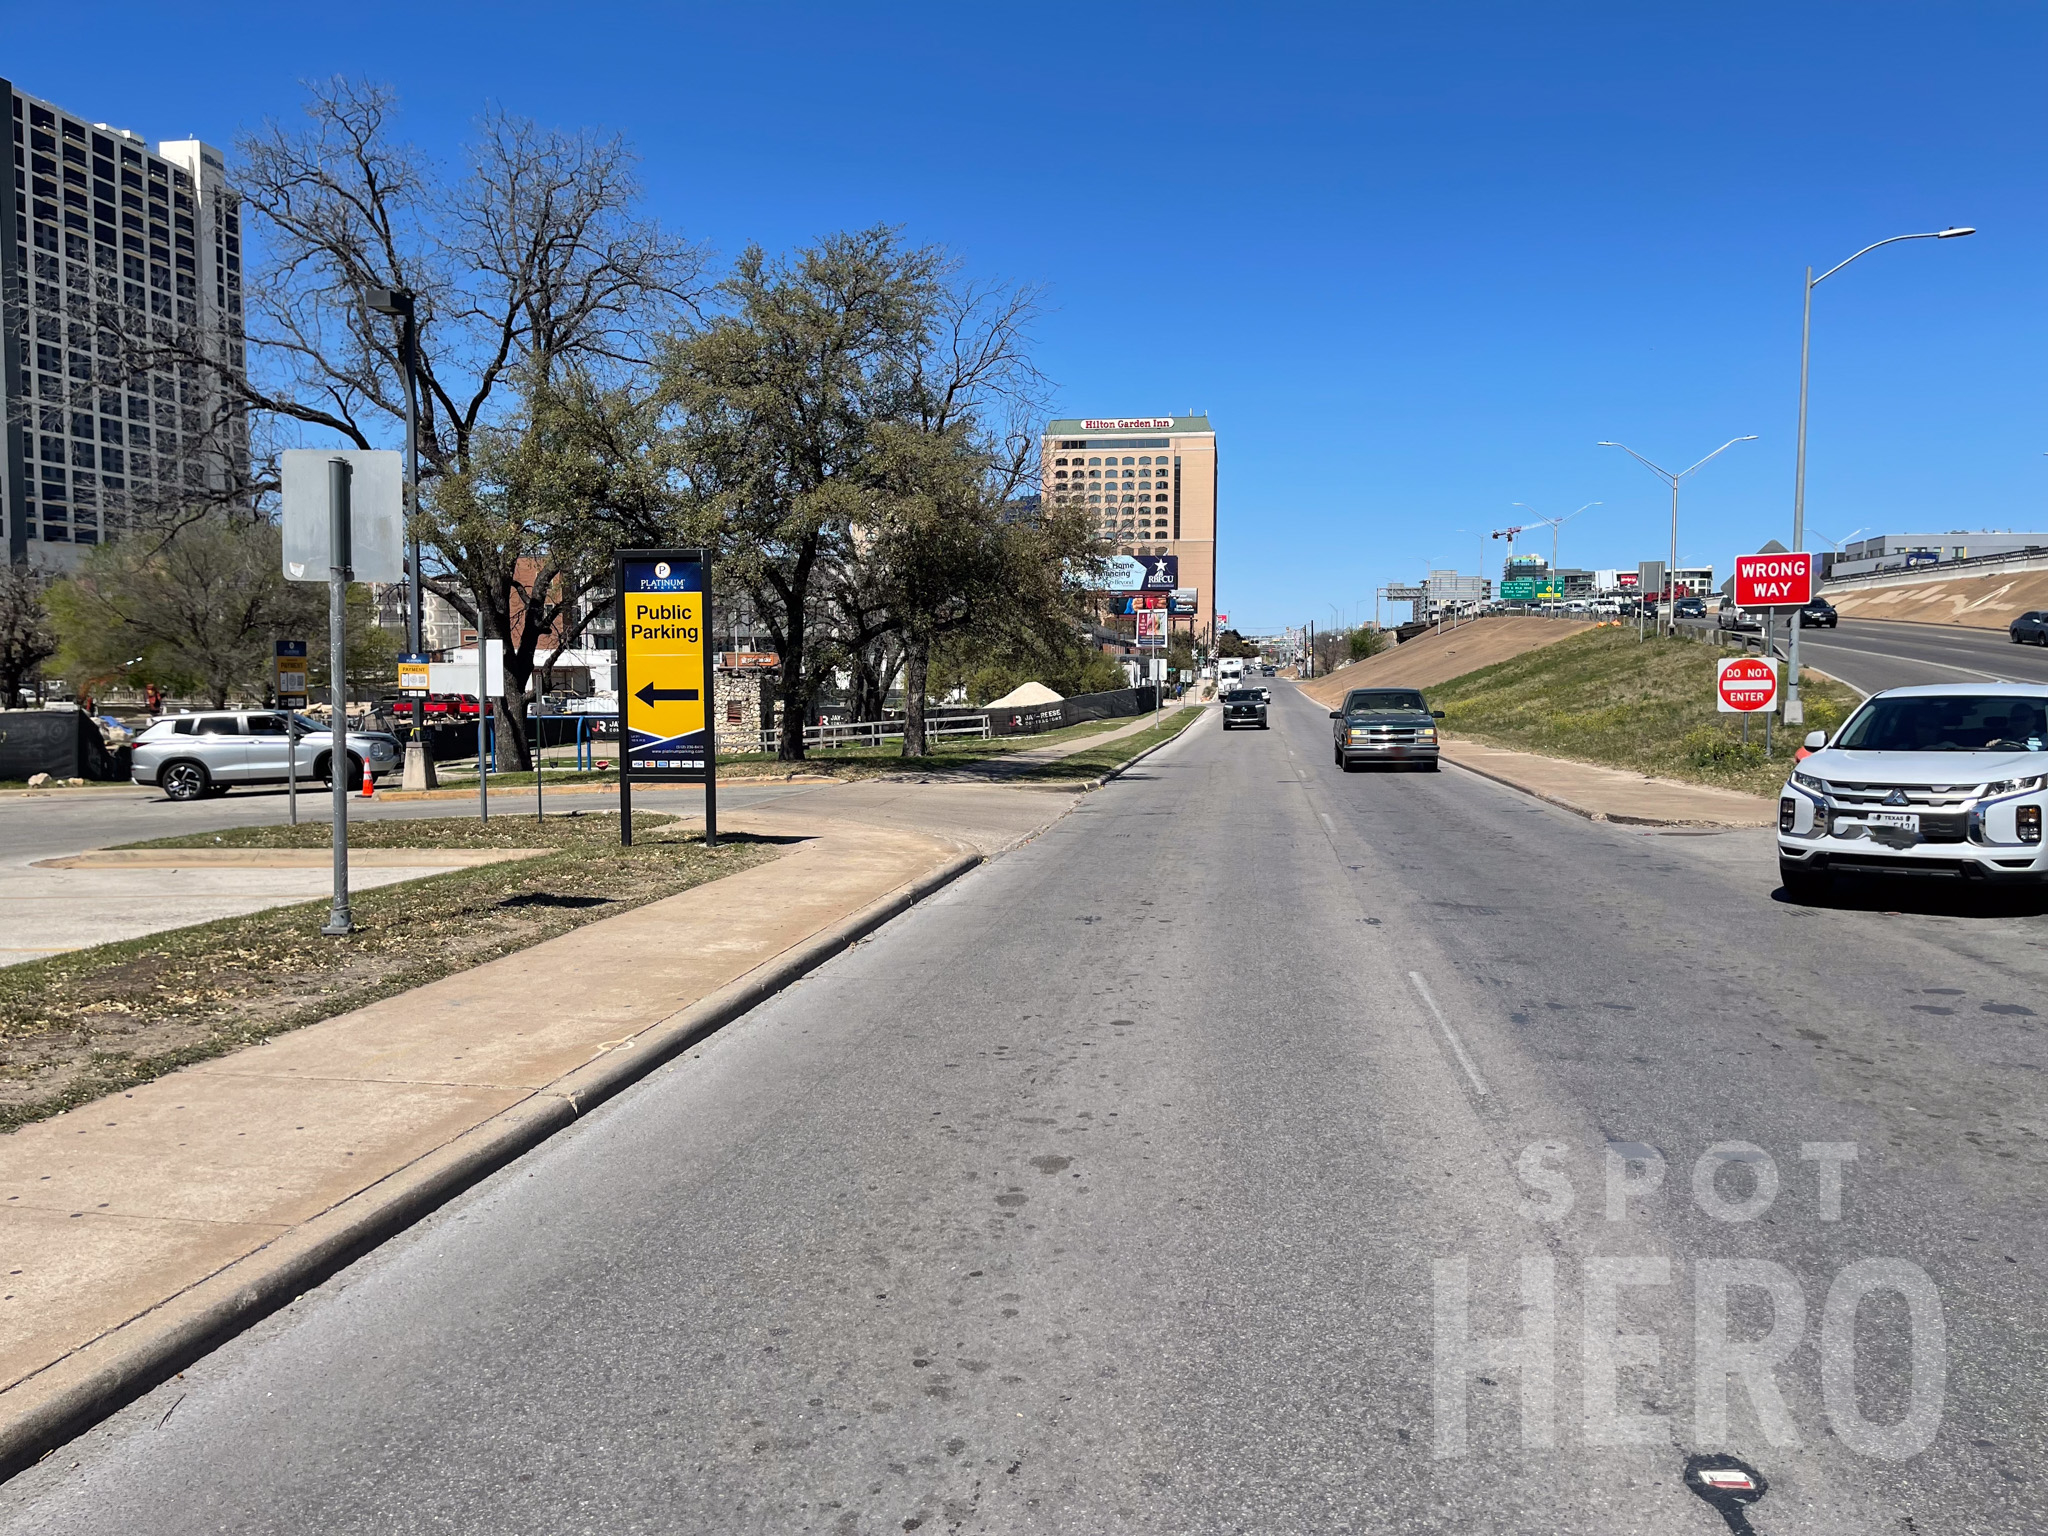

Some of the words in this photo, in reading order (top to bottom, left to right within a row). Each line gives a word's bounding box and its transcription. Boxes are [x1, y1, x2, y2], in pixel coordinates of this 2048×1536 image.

[1085, 420, 1115, 429] Hilton
[1118, 419, 1151, 428] Garden
[1153, 419, 1170, 428] Inn
[1741, 561, 1806, 579] WRONG
[640, 579, 684, 587] PLATINUM
[1753, 582, 1792, 598] WAY
[637, 605, 692, 620] Public
[631, 624, 699, 643] Parking
[1727, 668, 1741, 678] DO
[1747, 668, 1769, 678] NOT
[1730, 692, 1764, 702] ENTER
